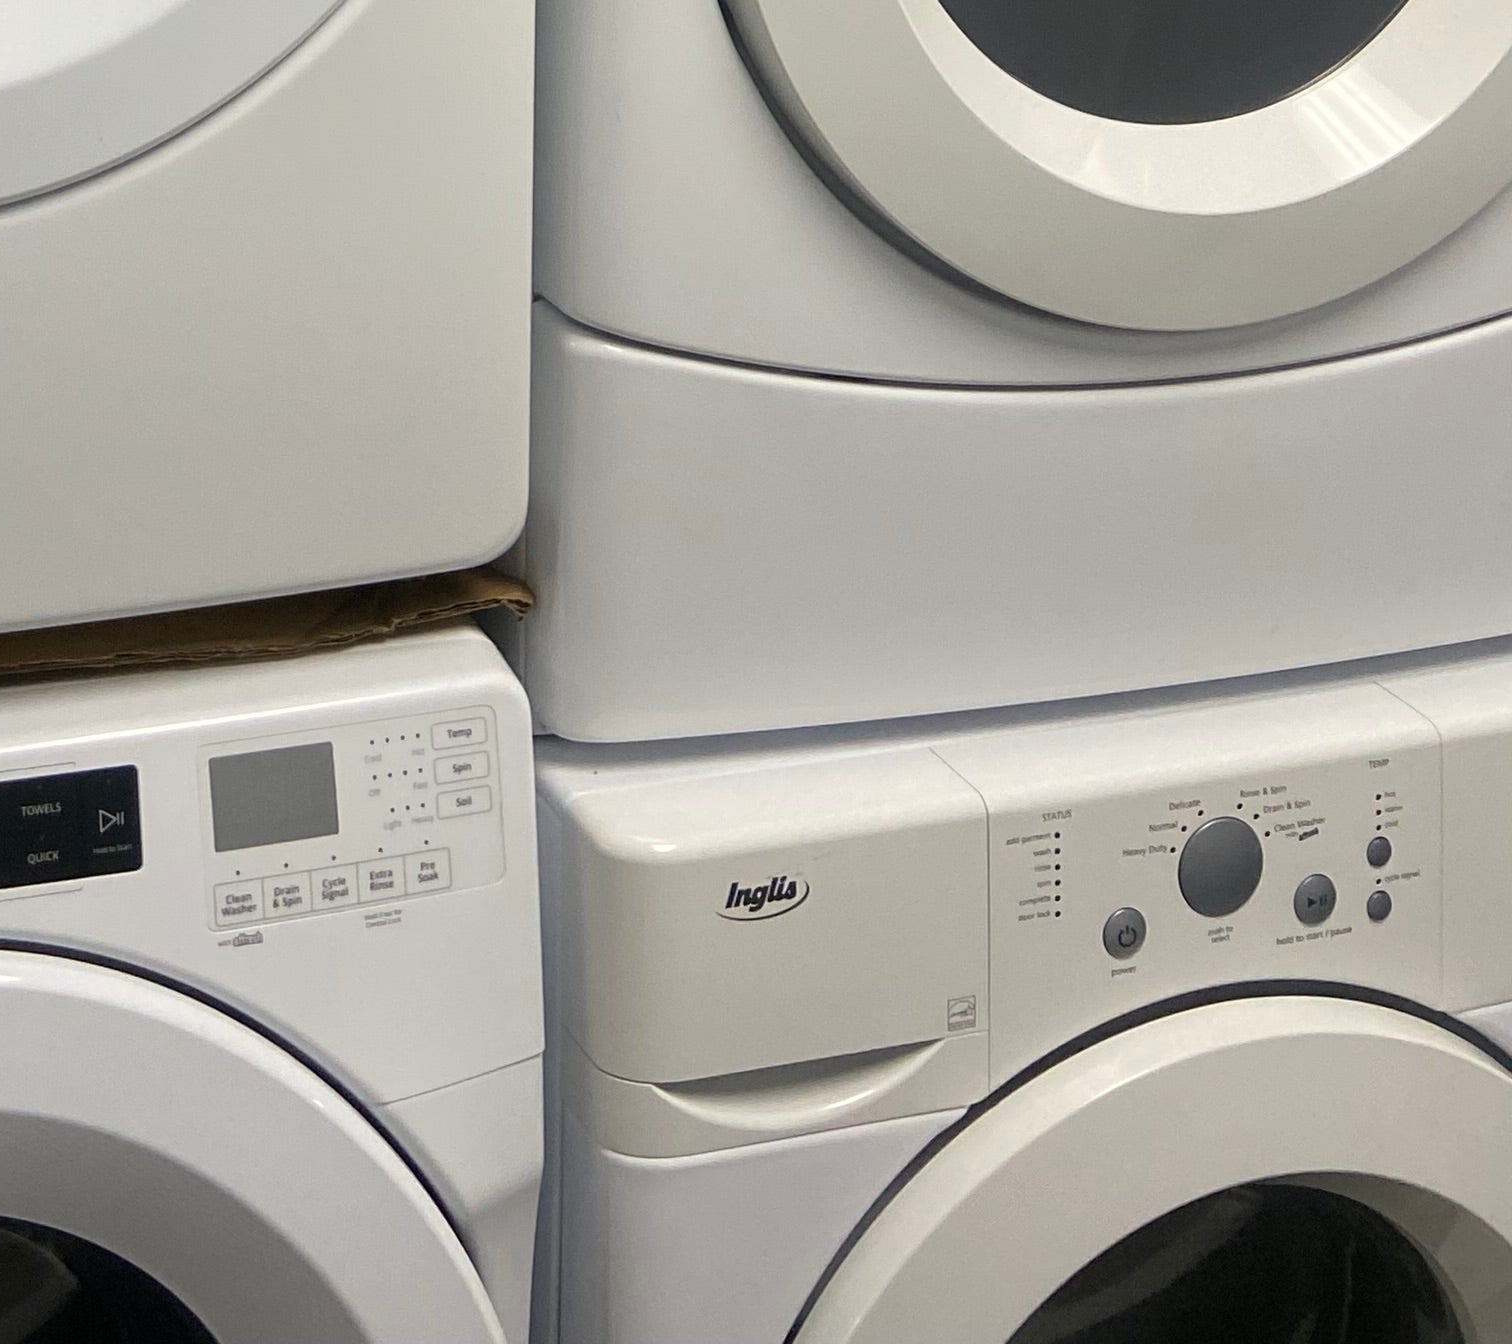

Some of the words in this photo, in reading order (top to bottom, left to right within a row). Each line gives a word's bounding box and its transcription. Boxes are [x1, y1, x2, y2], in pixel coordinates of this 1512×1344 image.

[447, 728, 472, 739] Temp
[452, 763, 472, 775] Spin
[456, 796, 472, 808] Soil
[20, 802, 62, 816] TOWELS
[26, 850, 60, 865] QUICK
[369, 869, 394, 881] Extra
[321, 876, 347, 890] Cycle
[274, 885, 300, 897] Drain
[321, 887, 349, 901] Signal
[725, 875, 797, 913] Inglis
[225, 893, 253, 906] Clean
[282, 895, 303, 908] Spin
[221, 903, 257, 917] Washer
